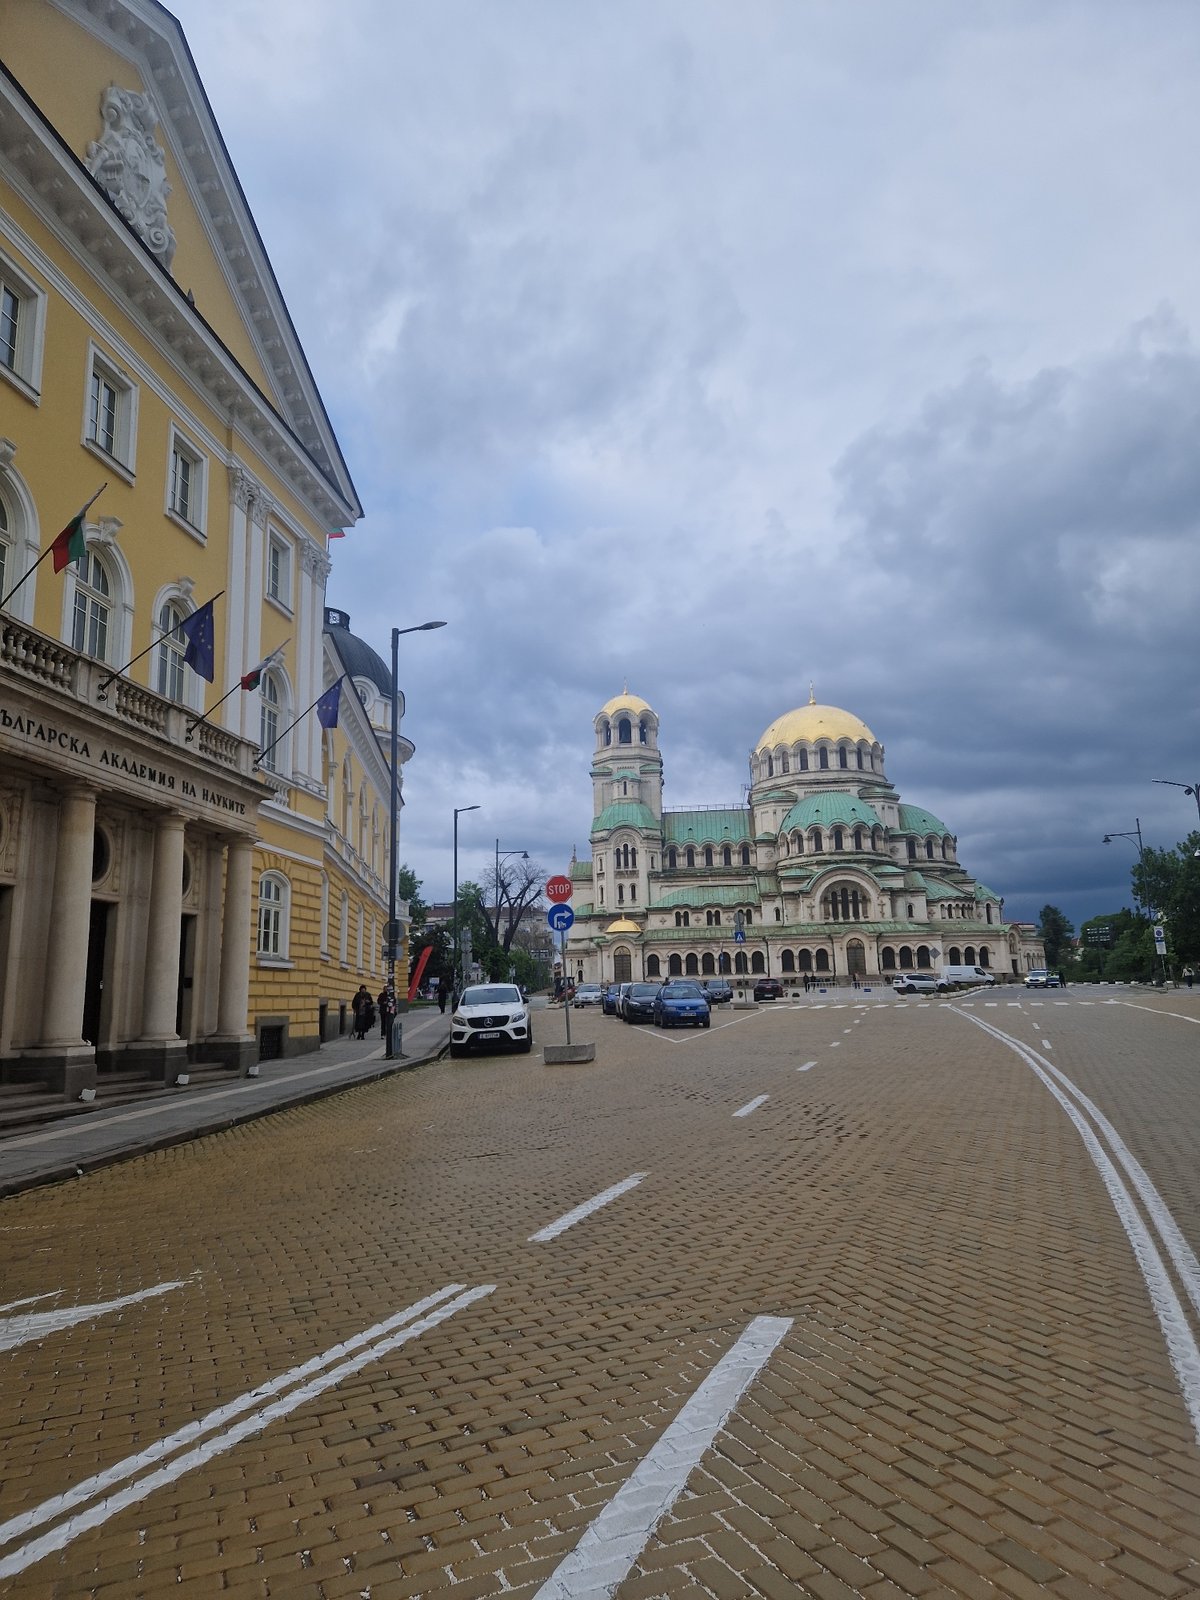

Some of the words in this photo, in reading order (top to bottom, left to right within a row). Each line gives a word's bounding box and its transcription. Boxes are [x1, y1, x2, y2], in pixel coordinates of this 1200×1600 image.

[99, 750, 175, 789] АКАДЕМИЯ
[182, 780, 197, 797] НА
[202, 788, 246, 815] НАУКИТЕ
[548, 884, 570, 895] STOP
